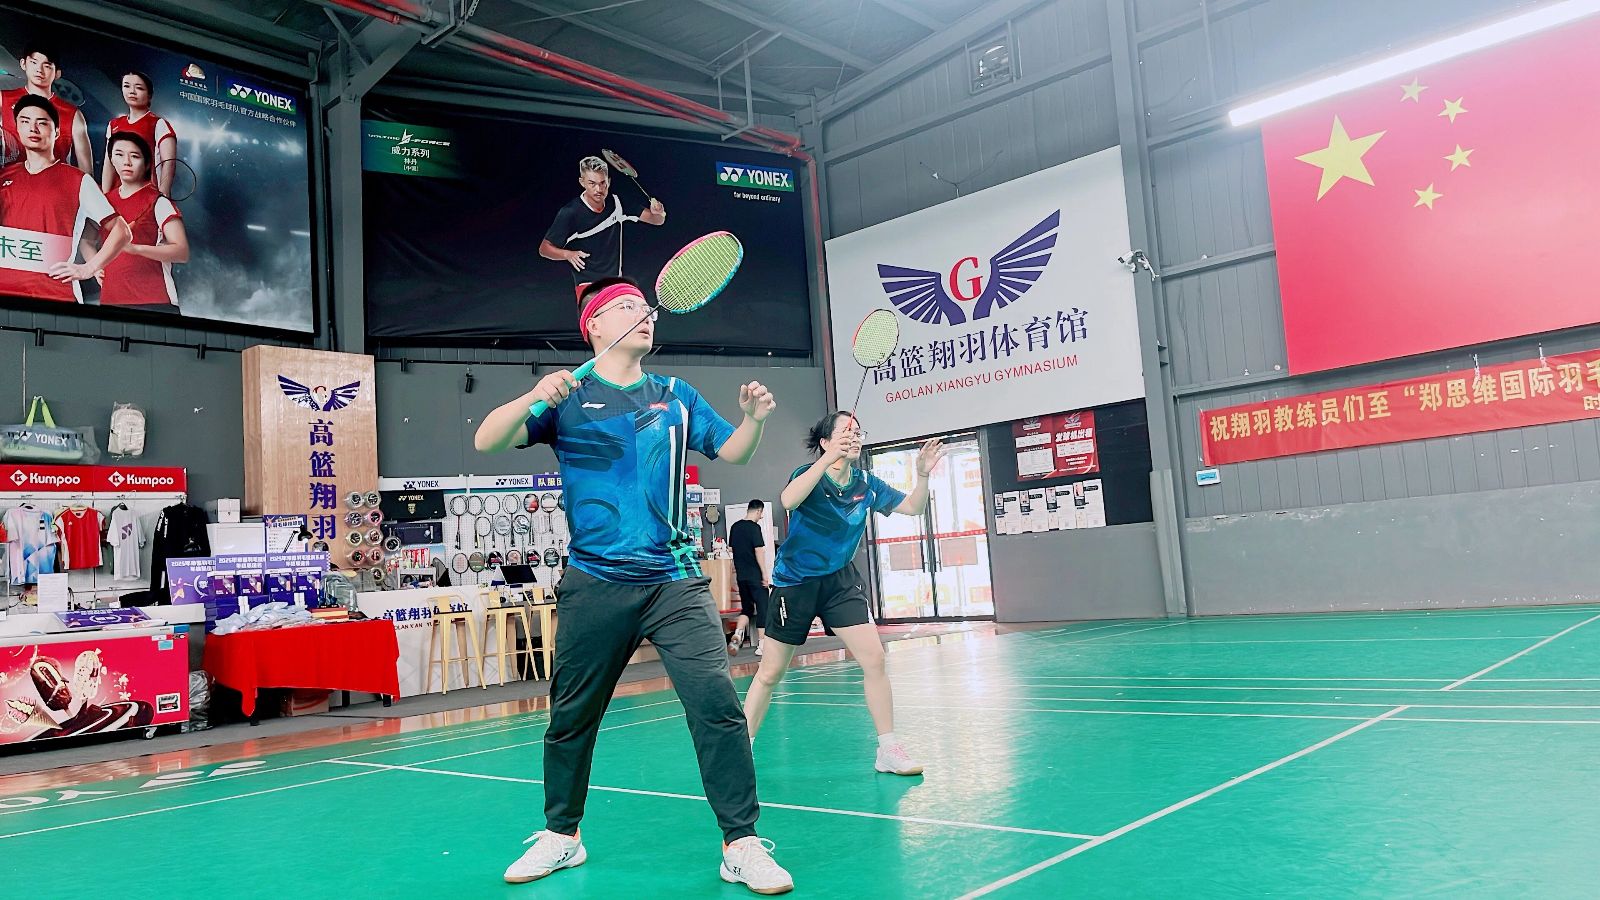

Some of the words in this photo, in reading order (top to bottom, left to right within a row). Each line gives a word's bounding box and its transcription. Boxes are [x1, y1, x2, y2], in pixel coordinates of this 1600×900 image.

[254, 90, 292, 111] YONEX
[391, 146, 430, 158] 威力系列
[746, 168, 790, 188] YONEX
[885, 384, 933, 404] GAOLAN
[936, 372, 991, 394] XIANGYU
[994, 354, 1079, 382] GYMNASIUM
[35, 433, 68, 447] YONEX
[29, 472, 81, 486] Kumpoo
[126, 474, 174, 487] Kumpoo
[308, 418, 337, 540] 高篮翔羽
[417, 480, 439, 488] YONEX
